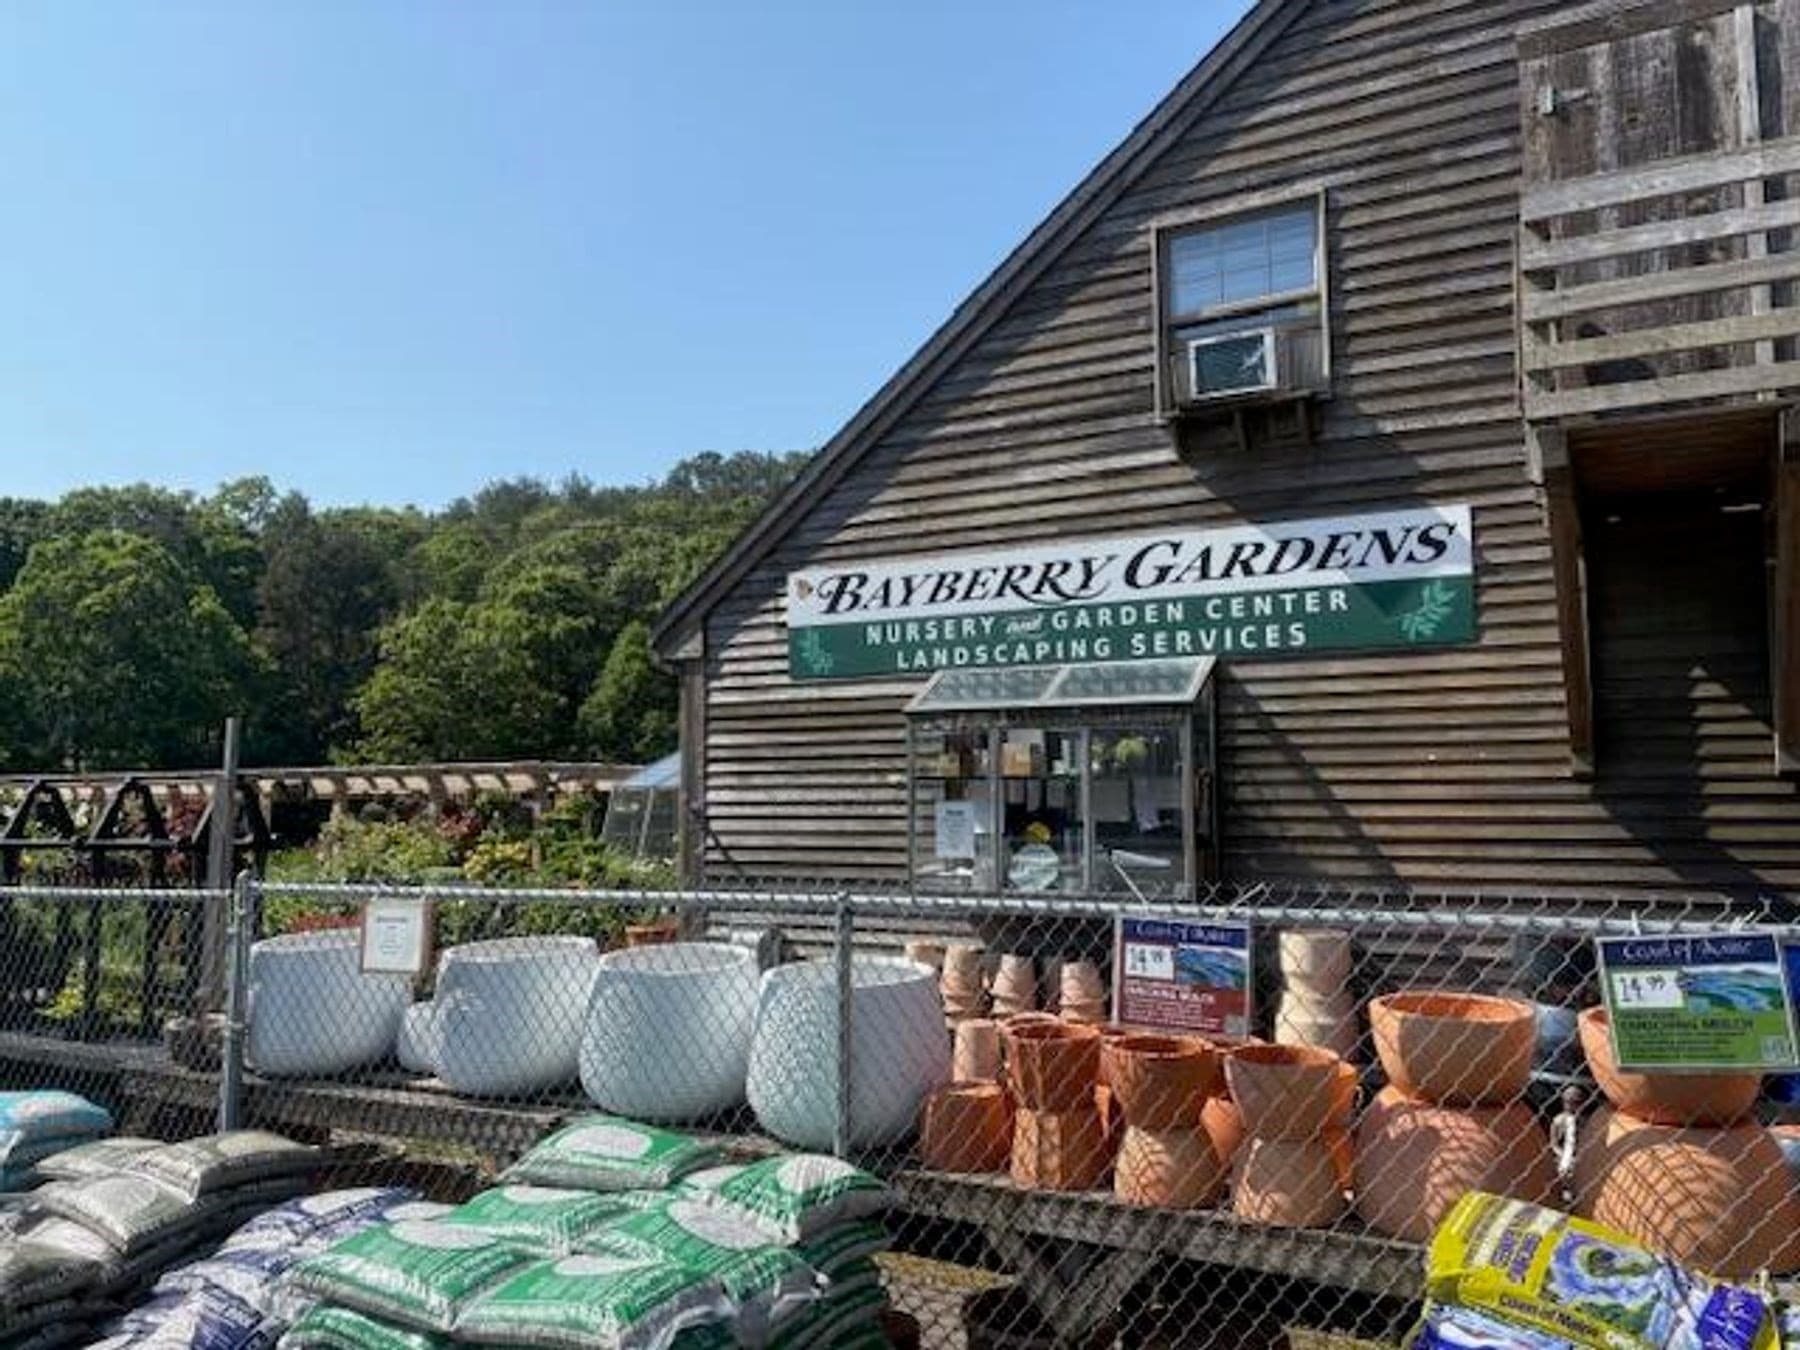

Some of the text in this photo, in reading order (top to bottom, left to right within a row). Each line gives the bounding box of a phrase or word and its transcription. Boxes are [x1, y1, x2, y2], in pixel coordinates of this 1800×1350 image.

[816, 522, 1456, 614] BAYBERRY GARDENS
[866, 588, 1350, 646] NURSERY and GARDEN CENTER
[896, 622, 1307, 669] LANDSCAPING SERVICES
